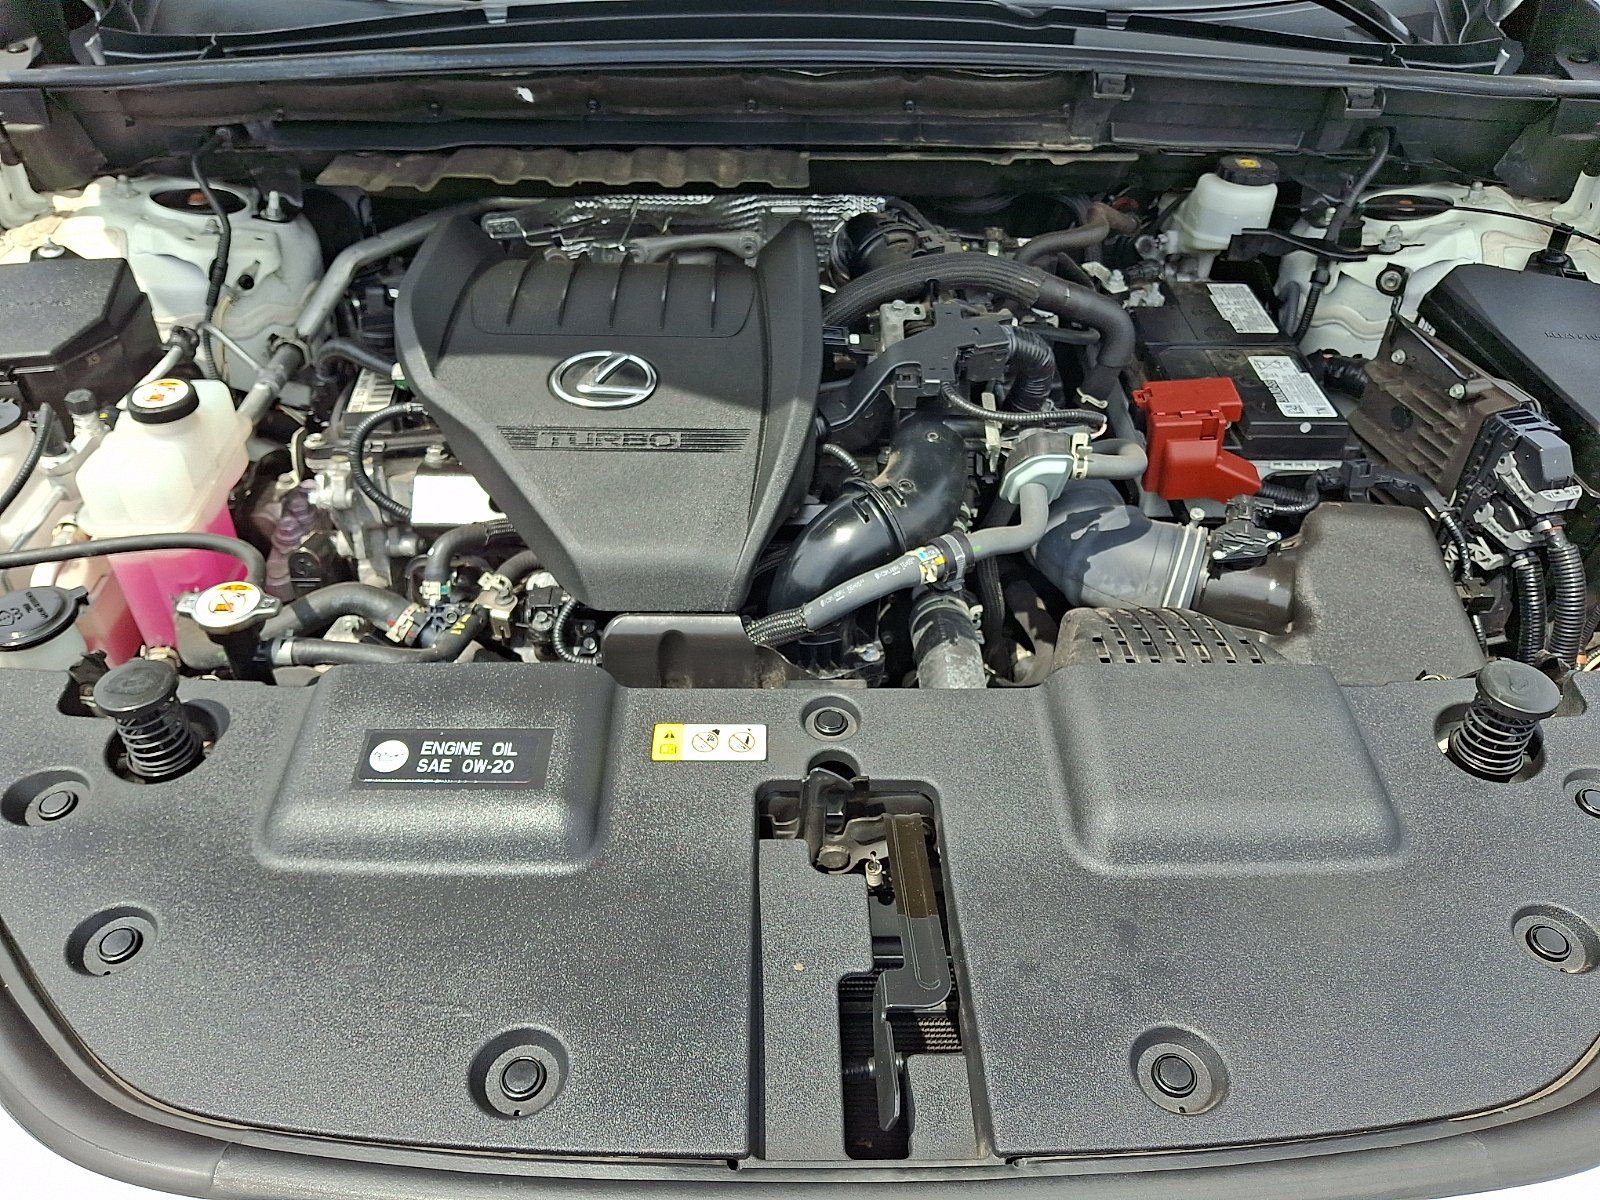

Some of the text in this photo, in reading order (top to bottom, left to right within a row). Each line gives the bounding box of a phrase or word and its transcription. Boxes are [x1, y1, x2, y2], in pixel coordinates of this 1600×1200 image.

[539, 431, 674, 448] TURBO
[420, 741, 518, 757] ENGINE OIL
[416, 759, 515, 774] SAE 0W-20
